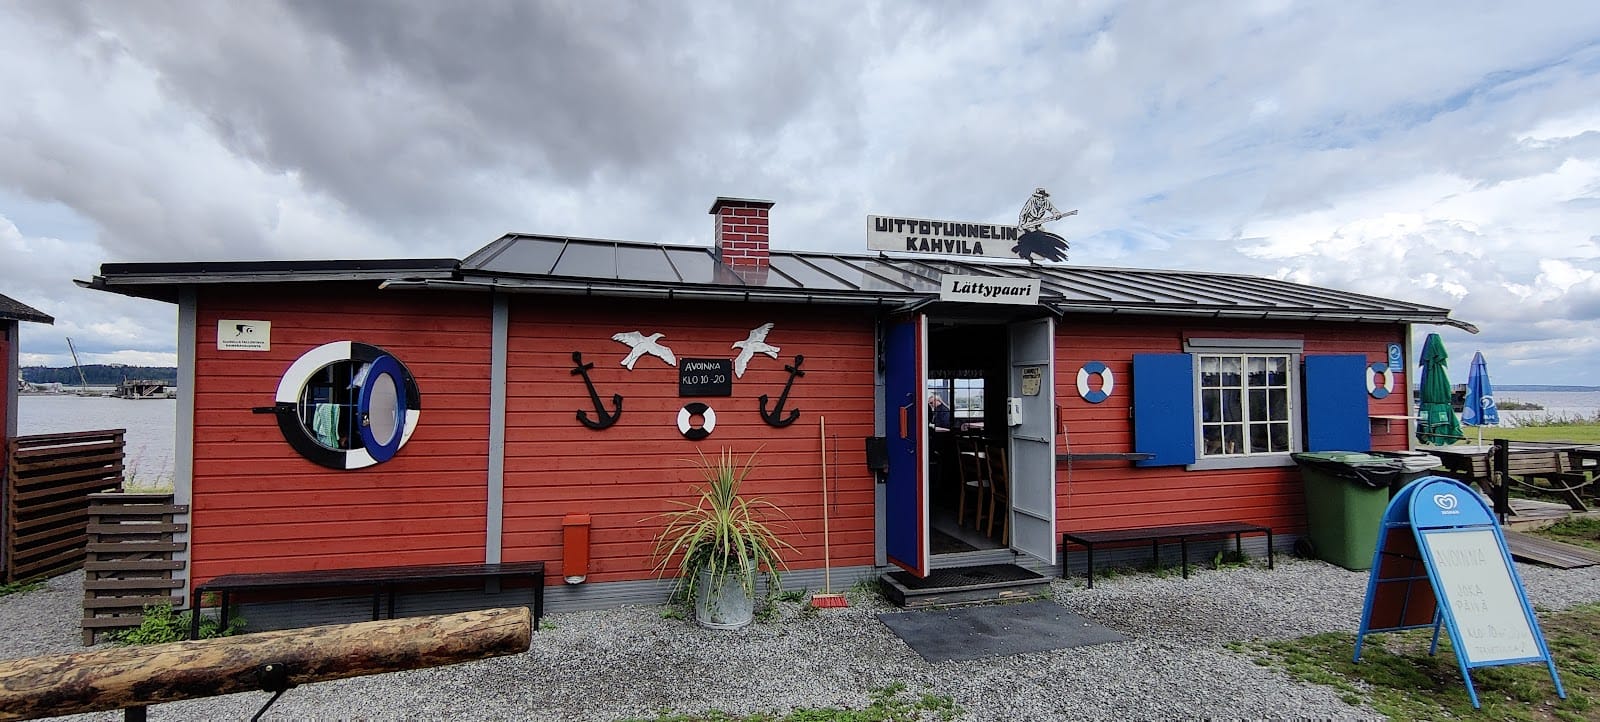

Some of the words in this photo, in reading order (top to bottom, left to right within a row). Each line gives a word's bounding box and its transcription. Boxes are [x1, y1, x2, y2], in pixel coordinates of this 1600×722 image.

[875, 217, 1018, 241] UITTOTUNNELIN
[906, 236, 984, 255] KAHVILA
[951, 281, 1032, 298] Lättypaari
[685, 362, 720, 371] AVOINNA
[683, 375, 698, 384] KLO
